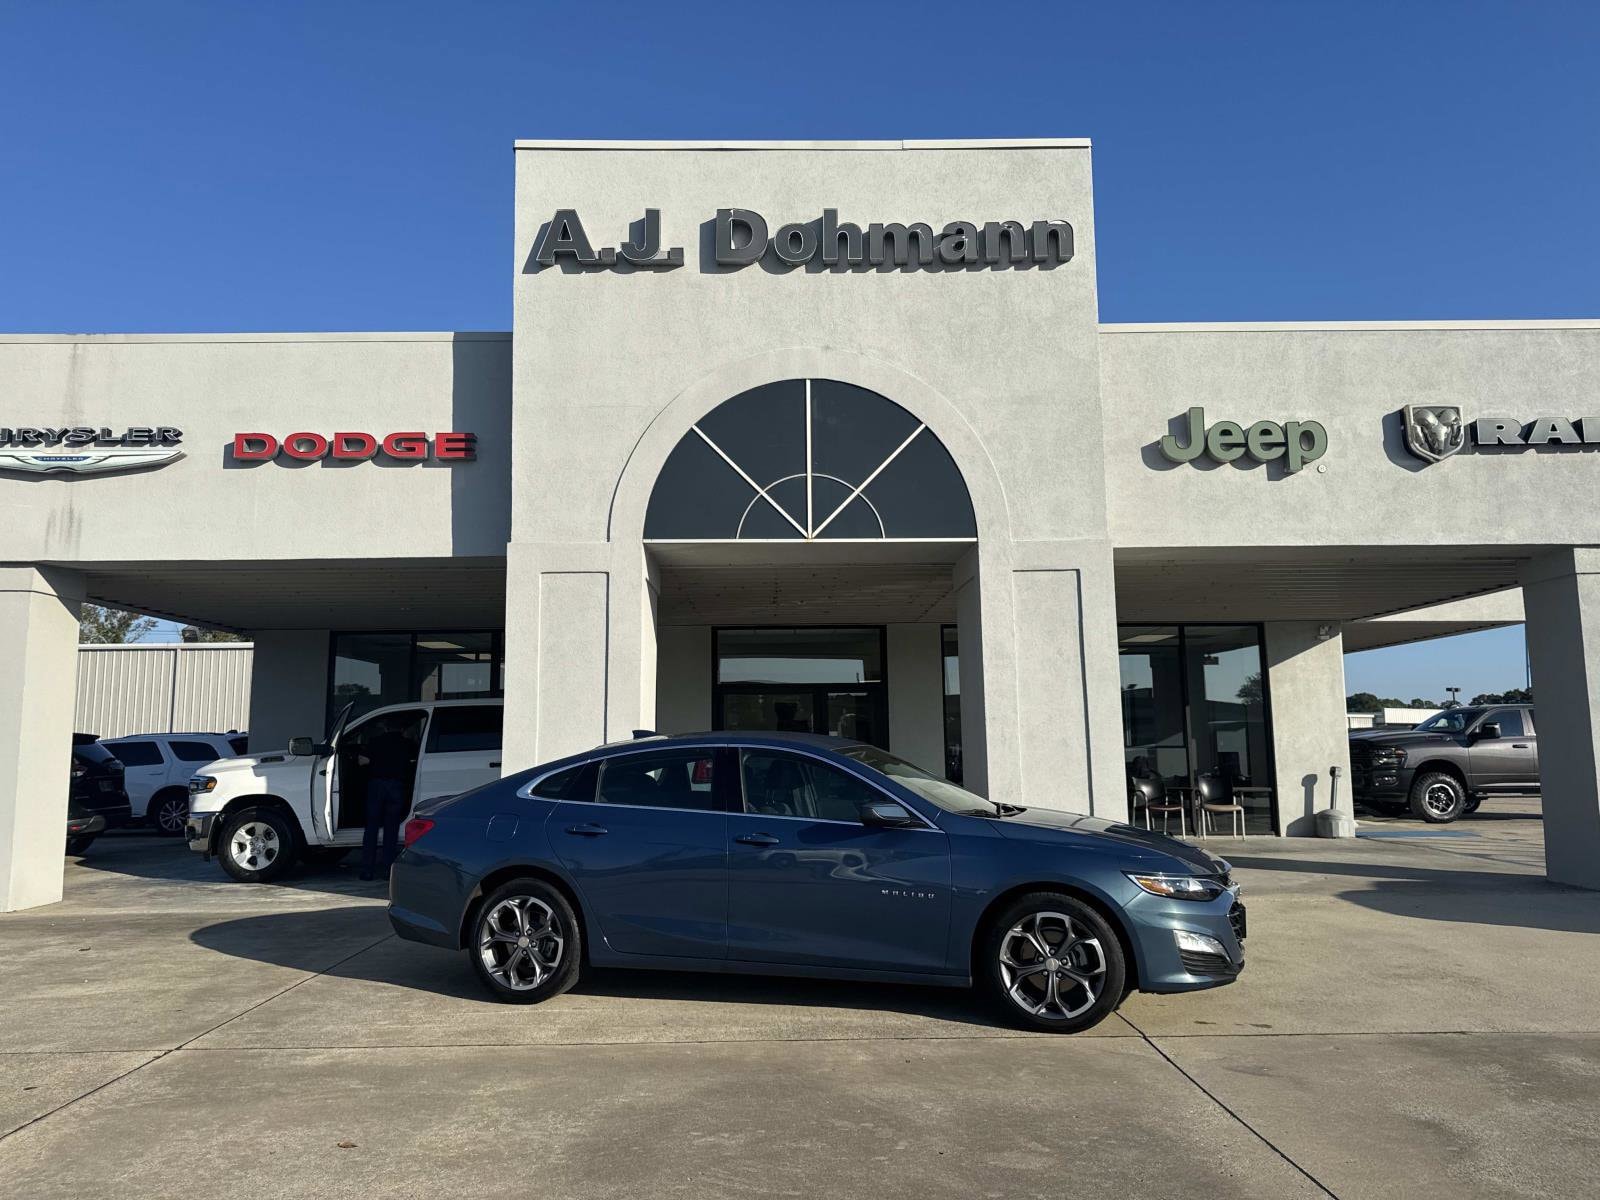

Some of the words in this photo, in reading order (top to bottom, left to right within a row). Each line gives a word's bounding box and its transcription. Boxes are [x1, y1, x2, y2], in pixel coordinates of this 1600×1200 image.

[535, 208, 684, 265] A.J.
[716, 207, 1075, 266] Dohmann
[232, 431, 476, 460] DODGE
[1160, 406, 1328, 472] Jeep
[881, 889, 935, 898] MALIBU
